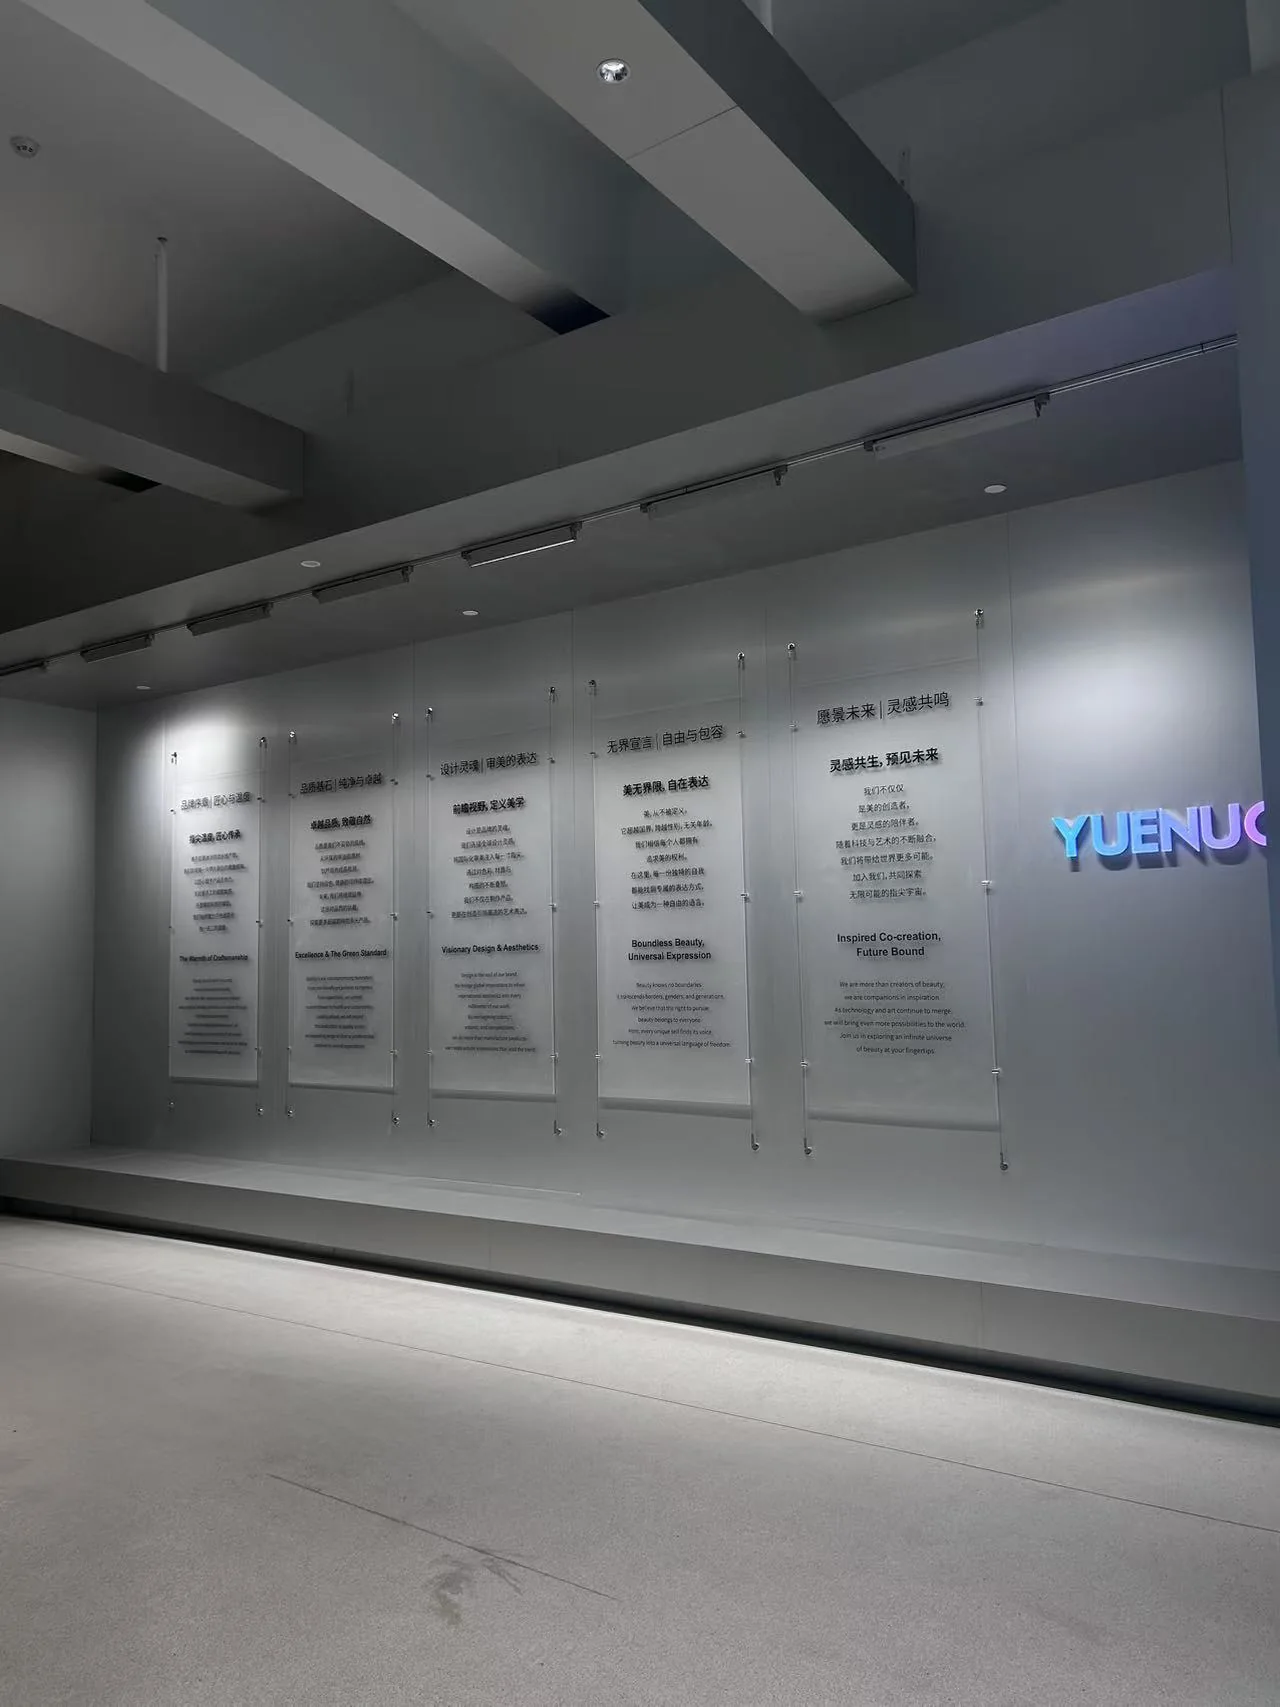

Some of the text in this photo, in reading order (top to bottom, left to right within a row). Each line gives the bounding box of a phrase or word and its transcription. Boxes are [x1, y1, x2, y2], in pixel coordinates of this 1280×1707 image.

[817, 704, 876, 725] 愿景未来
[888, 692, 950, 715] 灵感共鸣
[607, 737, 652, 753] 无界宣言
[663, 726, 723, 746] 自由与包容
[830, 748, 939, 773] 灵感共生，预见未来
[623, 775, 709, 796] 美无界限，自在表达
[864, 784, 904, 796] 我们不仅仅
[632, 938, 705, 948] Boundless Beauty,
[837, 931, 941, 944] Inspired Co-creation,
[442, 946, 471, 954] Visionary
[472, 945, 496, 953] Design
[503, 944, 538, 952] Aesthetics
[856, 946, 925, 957] Future Bound
[628, 951, 712, 961] Universal Expression
[891, 1020, 926, 1028] possibilities
[867, 1033, 895, 1041] exploring
